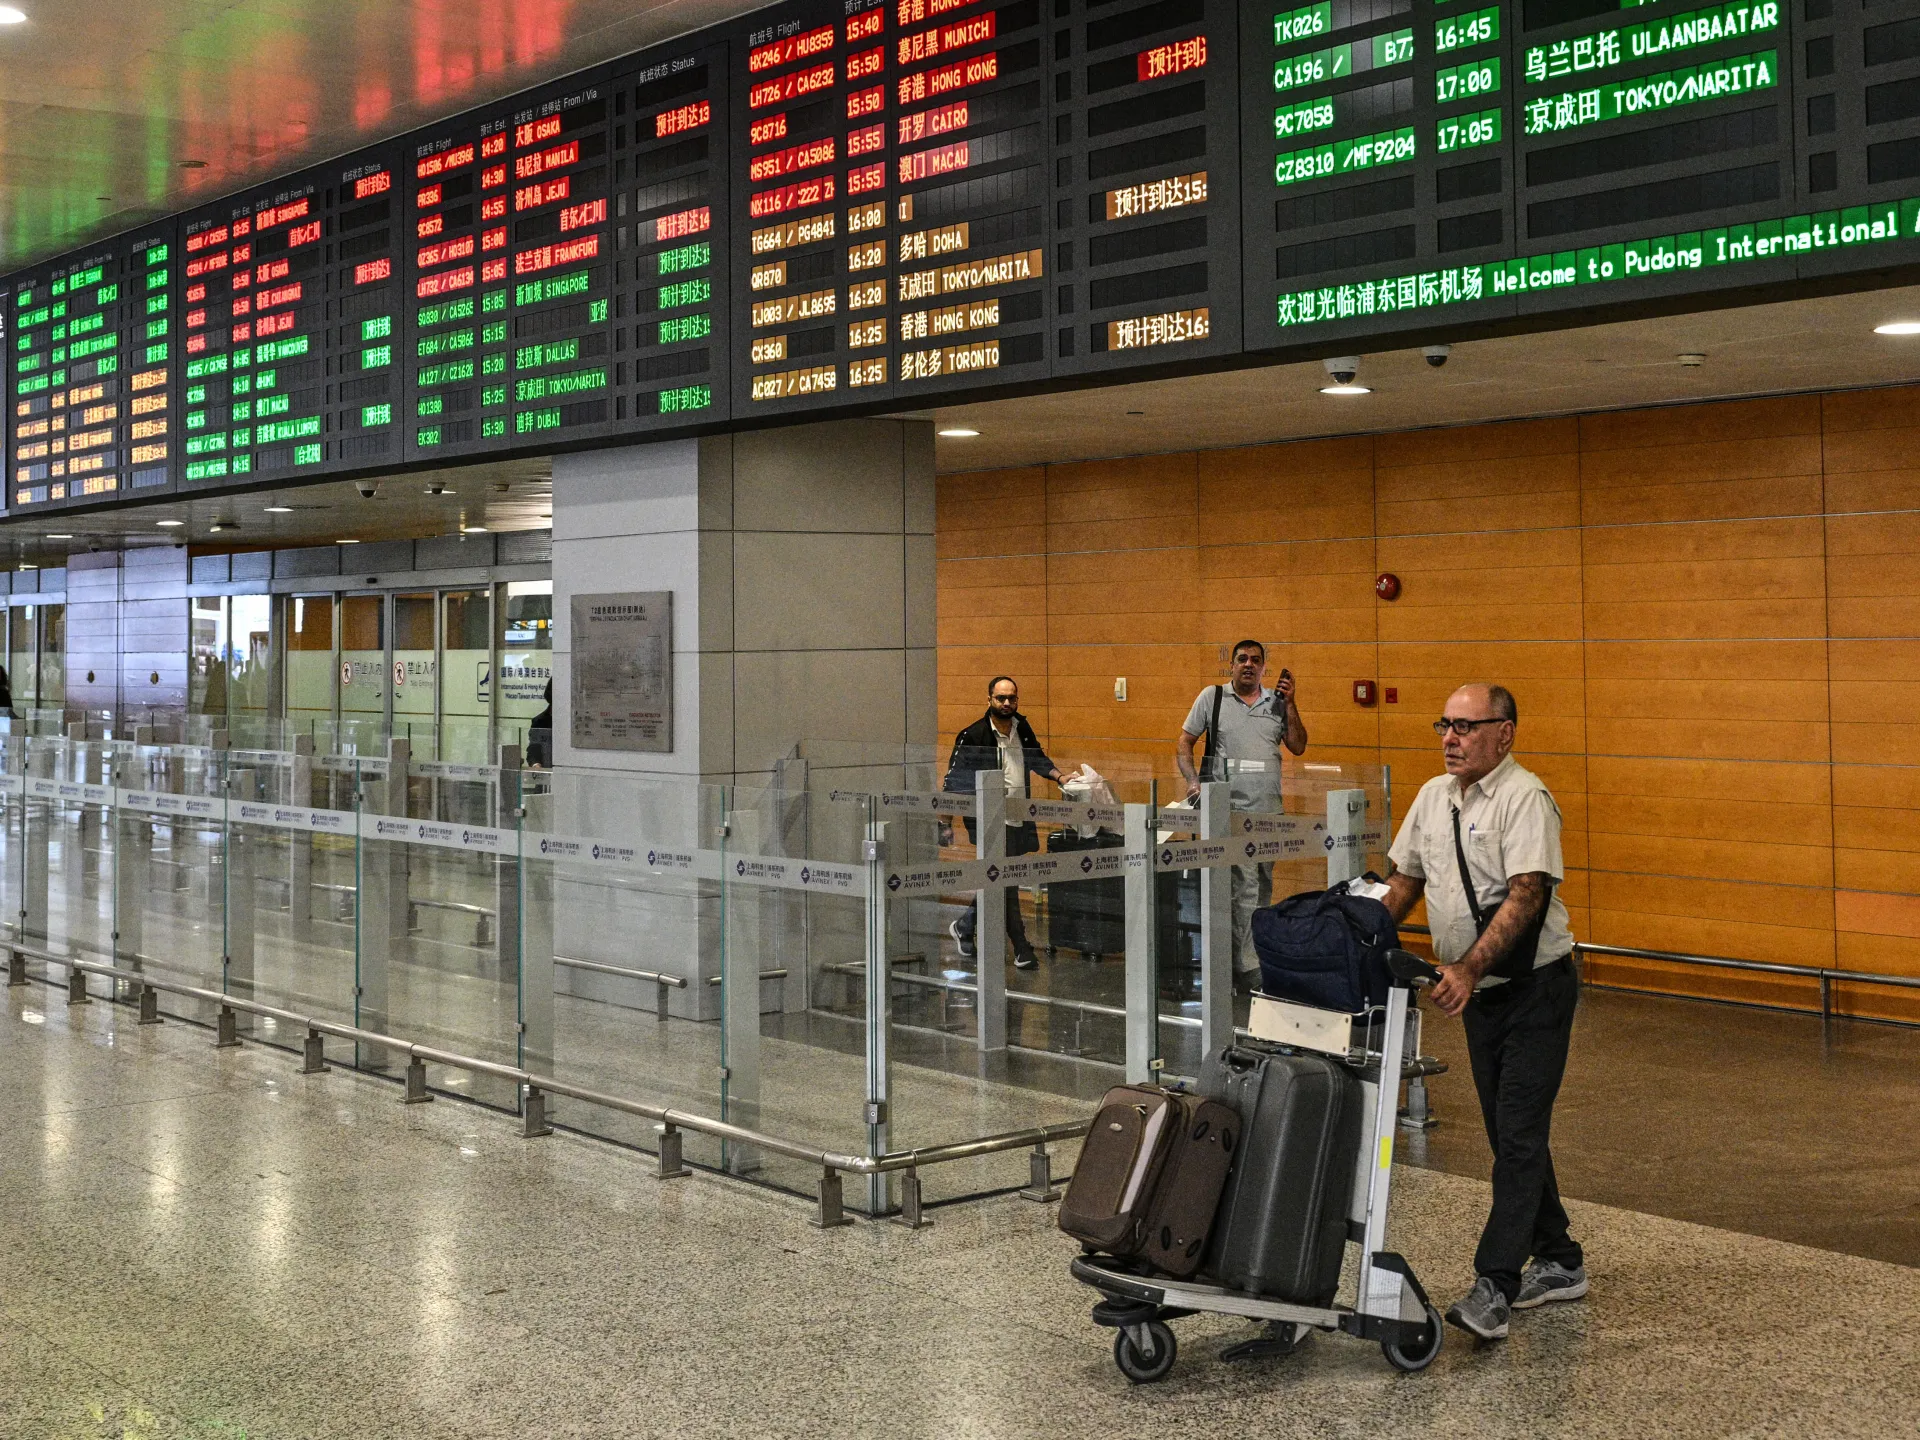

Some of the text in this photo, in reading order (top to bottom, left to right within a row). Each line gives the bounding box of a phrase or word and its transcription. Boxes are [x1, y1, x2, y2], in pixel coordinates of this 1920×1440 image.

[898, 0, 925, 26] 香港
[750, 20, 800, 46] 航班号 Flight
[847, 15, 879, 42] 15:40
[1275, 12, 1323, 42] TK026
[1436, 17, 1491, 50] 16:45
[898, 19, 989, 64] 慕尼黑 MUNICH
[1525, 2, 1778, 82] 乌兰巴托 ULAANBAATAR
[672, 57, 695, 72] Status
[750, 48, 781, 72] HX246
[847, 54, 879, 79] 15:50
[898, 59, 997, 105] 香港 HONG KONG
[1275, 59, 1323, 88] CA196
[1437, 68, 1491, 100] 17:00
[750, 67, 834, 108] LH726 CA6232
[1614, 61, 1770, 114] TOKYO/NARITA
[848, 92, 880, 119] 15:50
[537, 120, 560, 139] OSAKA
[751, 119, 787, 143] 9C8716
[898, 108, 968, 145] 开罗 CAIRO
[1275, 105, 1334, 135] 9C7058
[848, 131, 880, 154] 15:55
[1438, 119, 1493, 149] 17:05
[482, 138, 504, 157] 14:20
[515, 148, 574, 178] 马尼拉 MANILA
[751, 157, 781, 180] MS951
[898, 148, 969, 183] 澳门 MACAU
[1276, 152, 1334, 182] CZ8310
[482, 170, 504, 188] 14:30
[848, 170, 880, 193] 15:55
[418, 190, 439, 208] PR336
[546, 183, 566, 200] JEJU
[482, 201, 504, 219] 14:55
[751, 195, 781, 216] NX116
[848, 209, 880, 231] 16:00
[482, 232, 504, 250] 15:00
[752, 219, 835, 252] TG664 PG4841
[900, 230, 962, 262] 多哈 DOHA
[516, 239, 598, 274] 法兰克福 FRANKFURT
[849, 248, 881, 269] 16:20
[482, 264, 504, 282] 15:05
[752, 268, 782, 289] QR870
[943, 259, 1030, 290] TOKYO/NARITA
[1278, 211, 1898, 326] 欢迎光临浦东国际机场 Welcome to Pudong International
[418, 280, 439, 297] LH732
[516, 275, 589, 306] 新加坡 SINGAPORE
[849, 287, 881, 308] 16:20
[482, 295, 504, 311] 15:05
[799, 295, 836, 317] JL8695
[901, 305, 999, 341] 香港 HONG KONG
[482, 327, 504, 342] 15:15
[849, 326, 881, 347] 16:25
[418, 341, 439, 355] ET684
[547, 345, 574, 362] DALLAS
[752, 342, 782, 361] CX360
[482, 358, 504, 374] 15:20
[901, 347, 999, 380] 多伦多 TORONTO
[418, 371, 439, 385] AA127
[549, 372, 606, 394] TOKYO/NARITA
[850, 365, 882, 385] 16:25
[482, 390, 504, 405] 15:25
[752, 380, 782, 398] AC027
[482, 421, 504, 436] 15:30
[538, 412, 561, 429] DUBAI
[1175, 855, 1198, 863] AVINEX
[1288, 845, 1300, 853] PVG
[904, 877, 956, 888] AVINEX PVG
[1003, 871, 1028, 879] AVINEX
